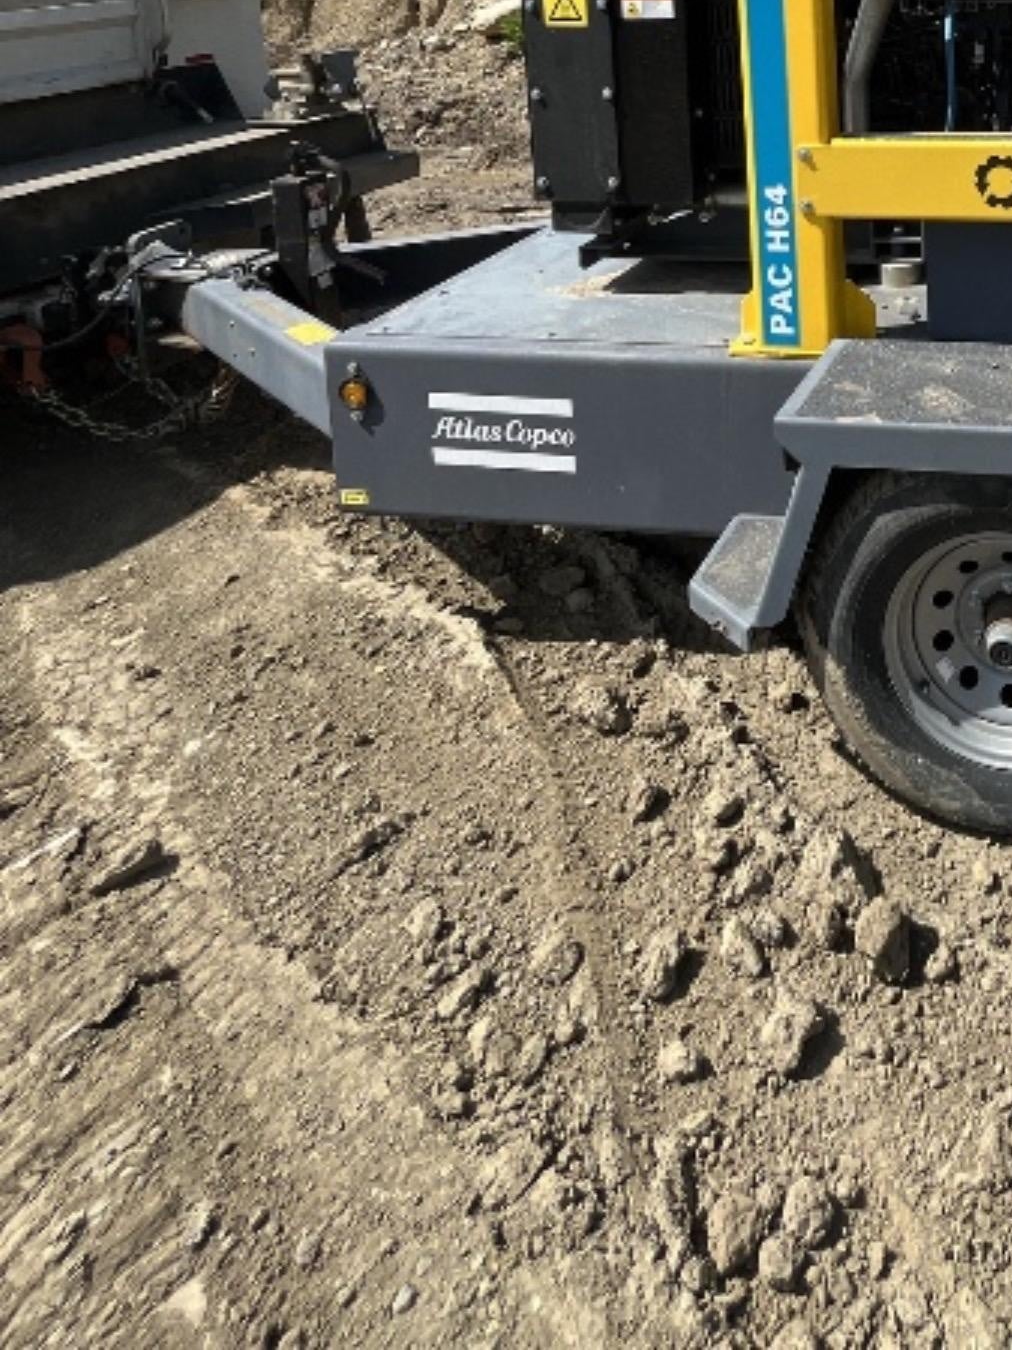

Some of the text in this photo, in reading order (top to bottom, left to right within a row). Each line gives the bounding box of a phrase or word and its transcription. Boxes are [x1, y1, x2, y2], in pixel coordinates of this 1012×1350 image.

[763, 183, 796, 335] PAC H64
[431, 416, 576, 450] Atlas Copco
